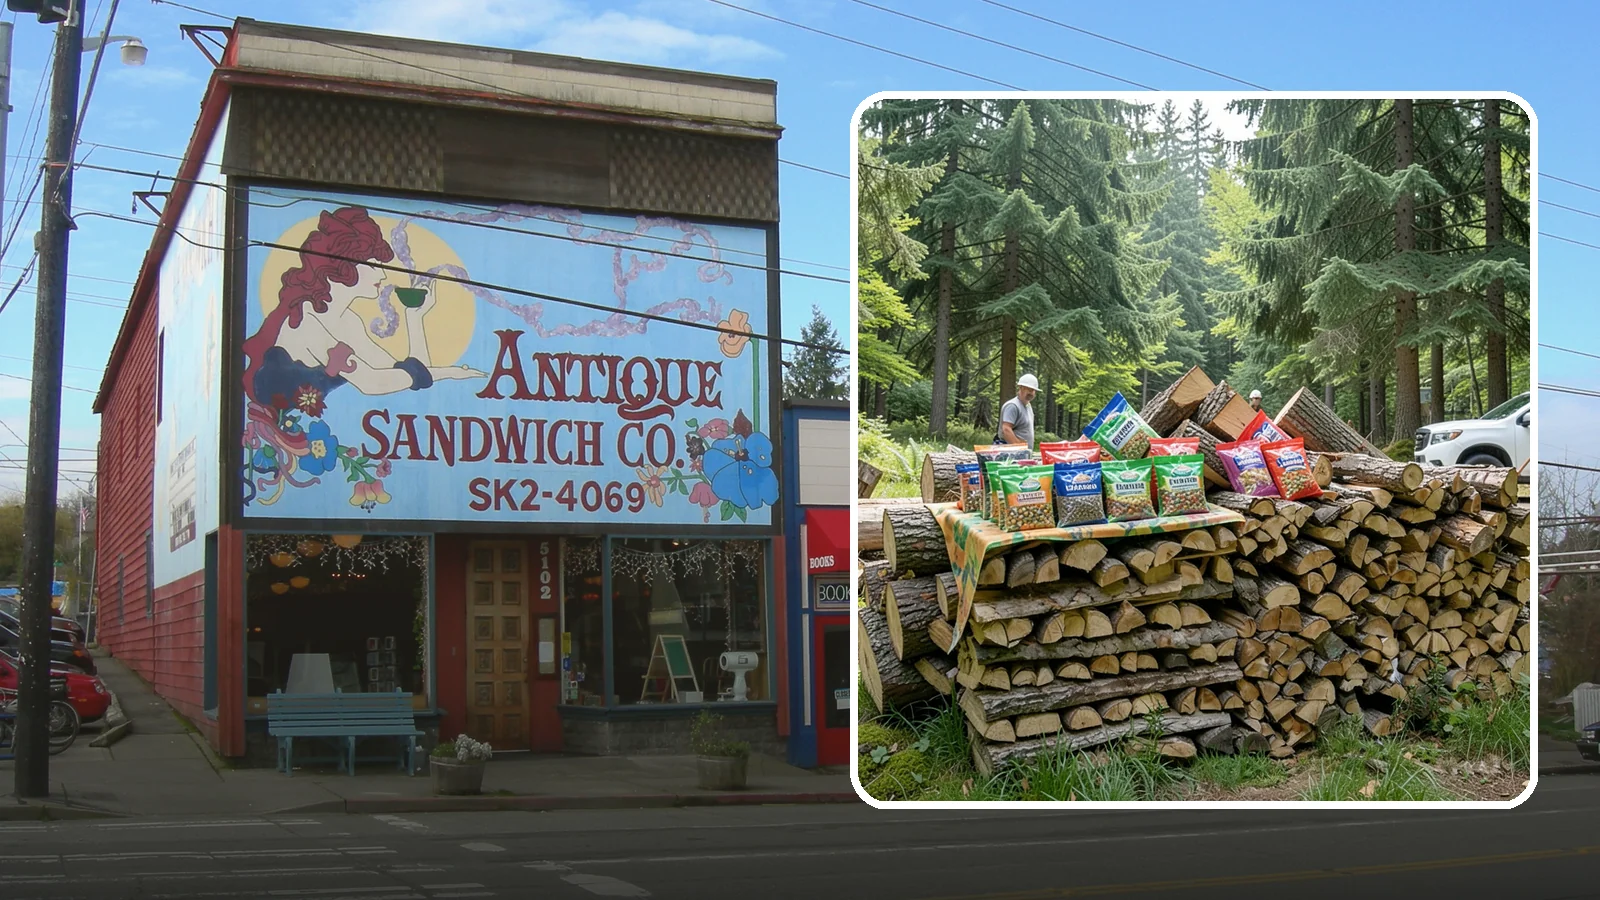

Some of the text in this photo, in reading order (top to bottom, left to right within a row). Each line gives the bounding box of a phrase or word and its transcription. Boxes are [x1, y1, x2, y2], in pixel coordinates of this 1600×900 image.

[476, 329, 723, 420] ANTIQUE
[361, 408, 685, 469] SANDWICH CO.
[468, 477, 645, 513] SK2-4069
[539, 541, 552, 600] 5102
[809, 555, 835, 569] BOOKS
